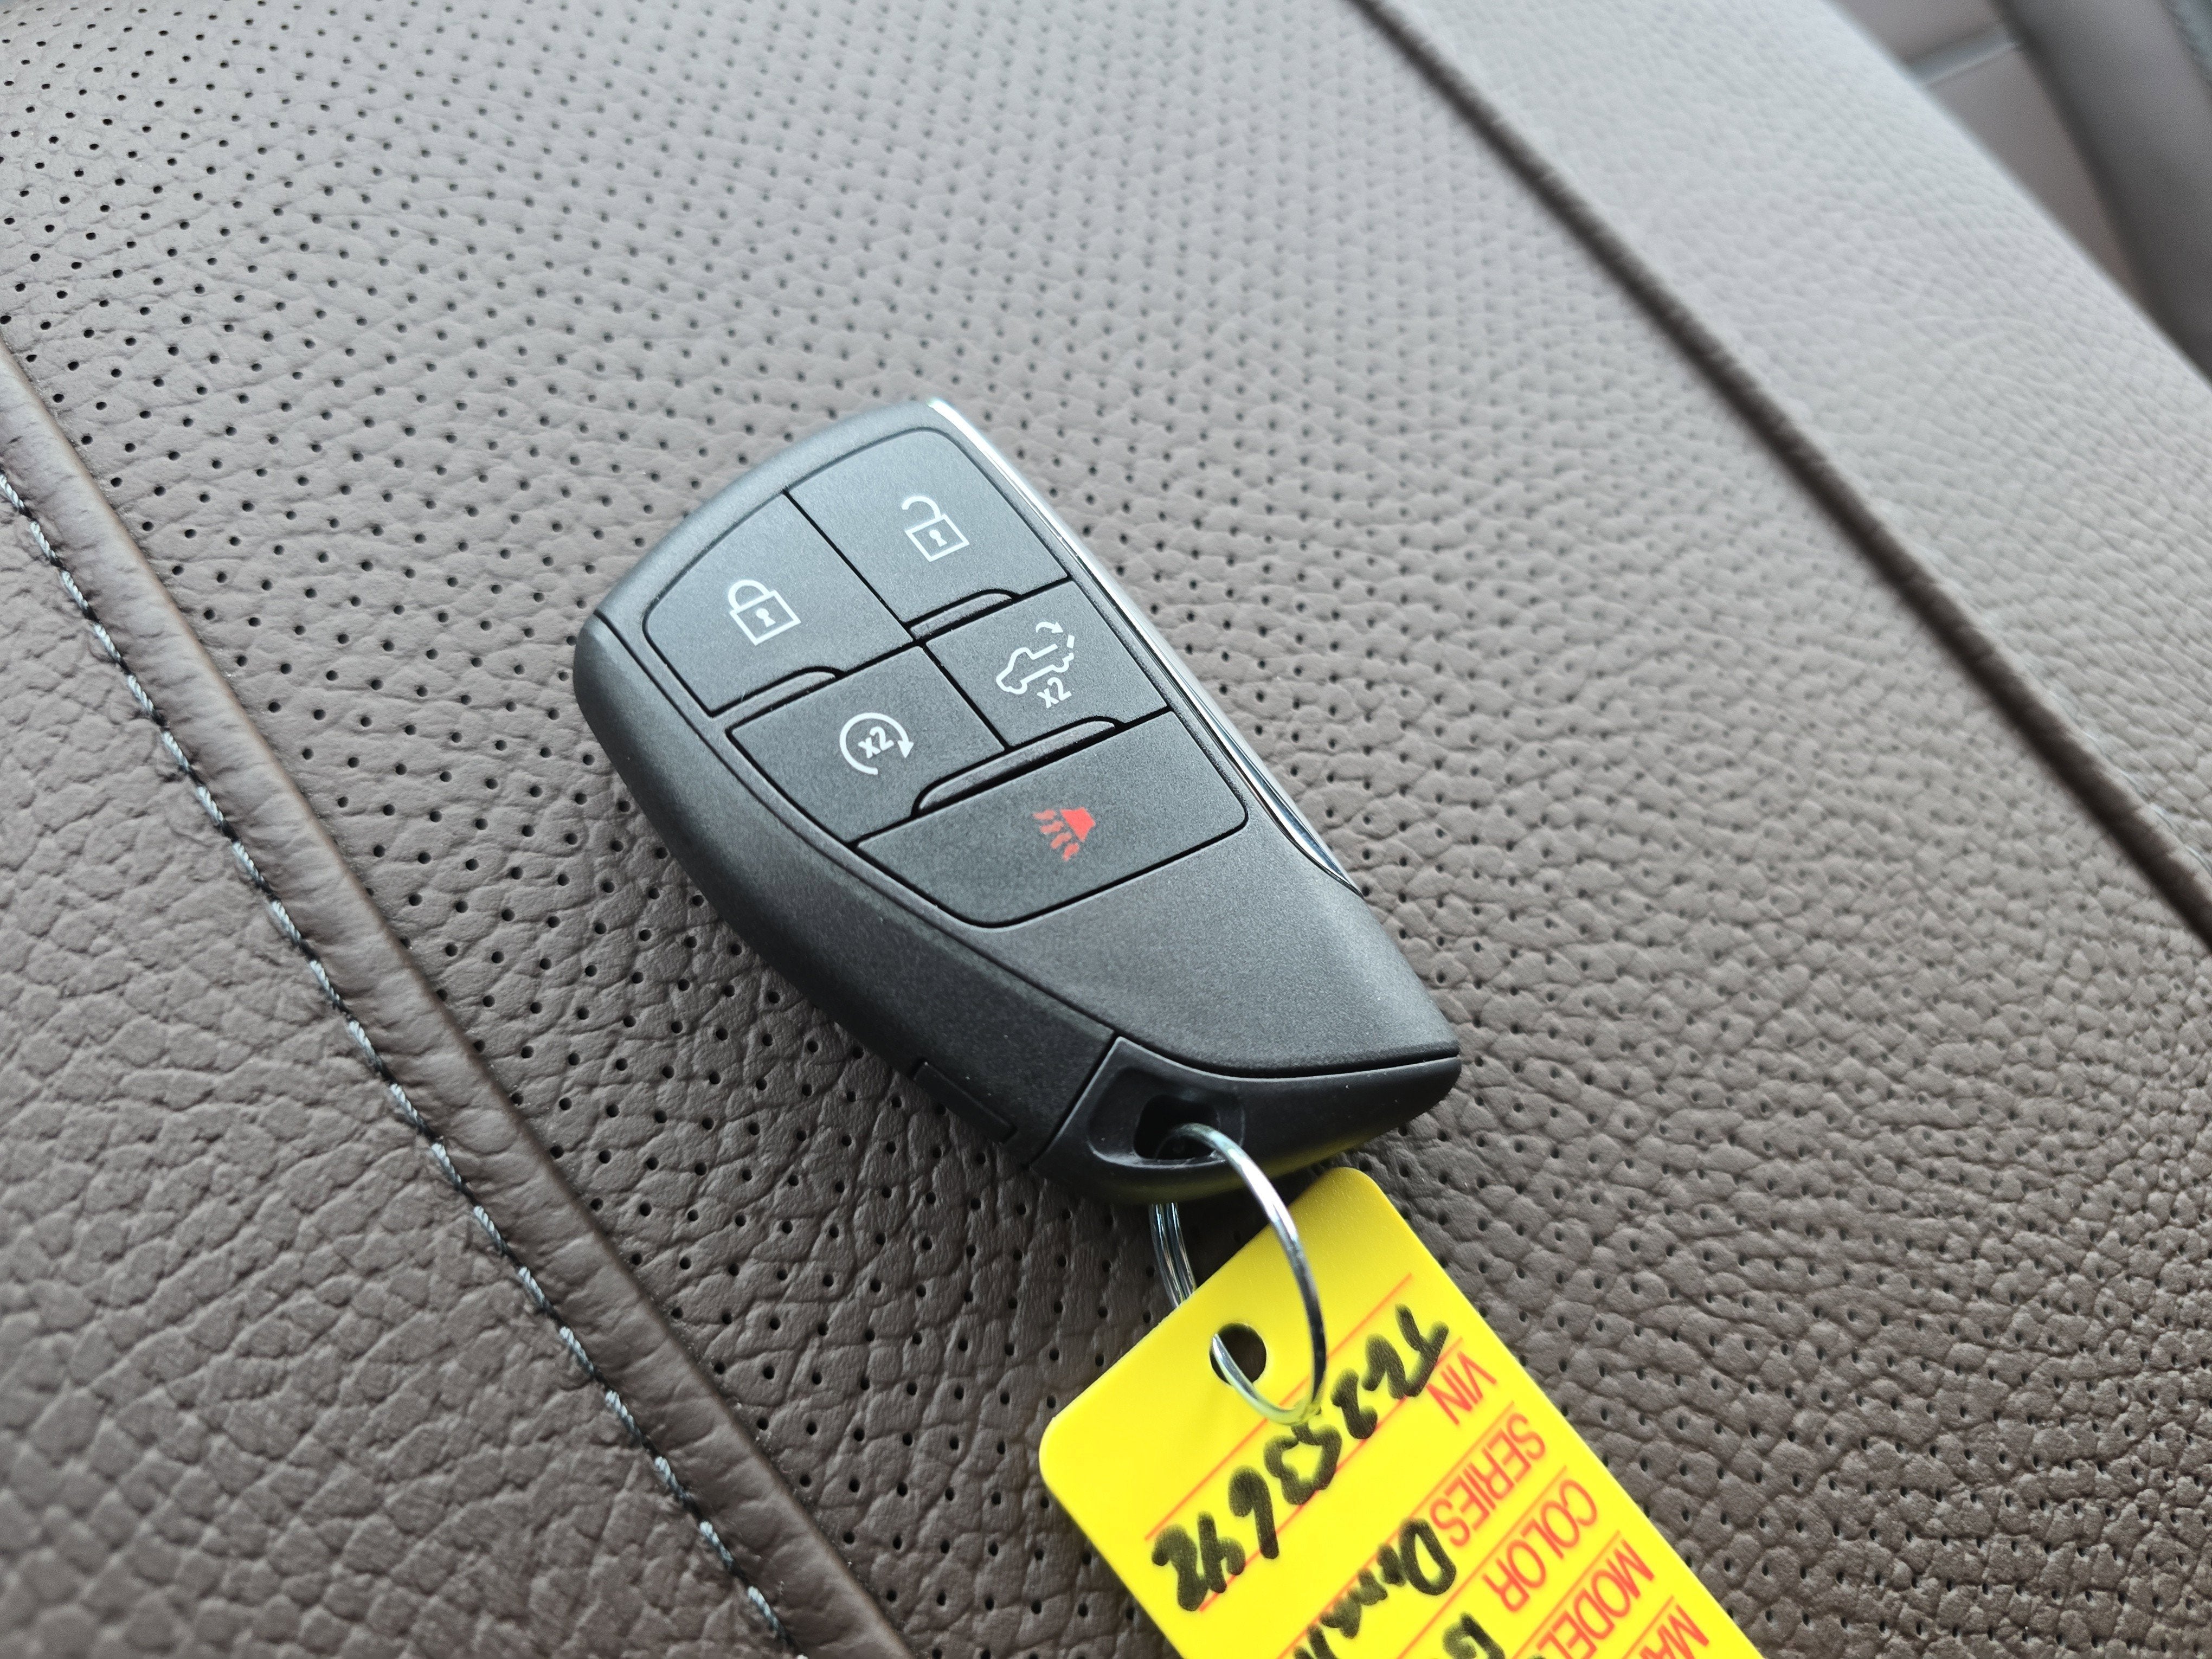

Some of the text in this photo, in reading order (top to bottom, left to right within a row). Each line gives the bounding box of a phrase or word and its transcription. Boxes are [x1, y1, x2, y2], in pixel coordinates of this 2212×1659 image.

[1037, 677, 1072, 709] x2
[858, 726, 894, 759] x2
[1426, 1350, 1498, 1426] VIN
[1429, 1412, 1546, 1548] SERIES
[1482, 1479, 1598, 1613] COLOR
